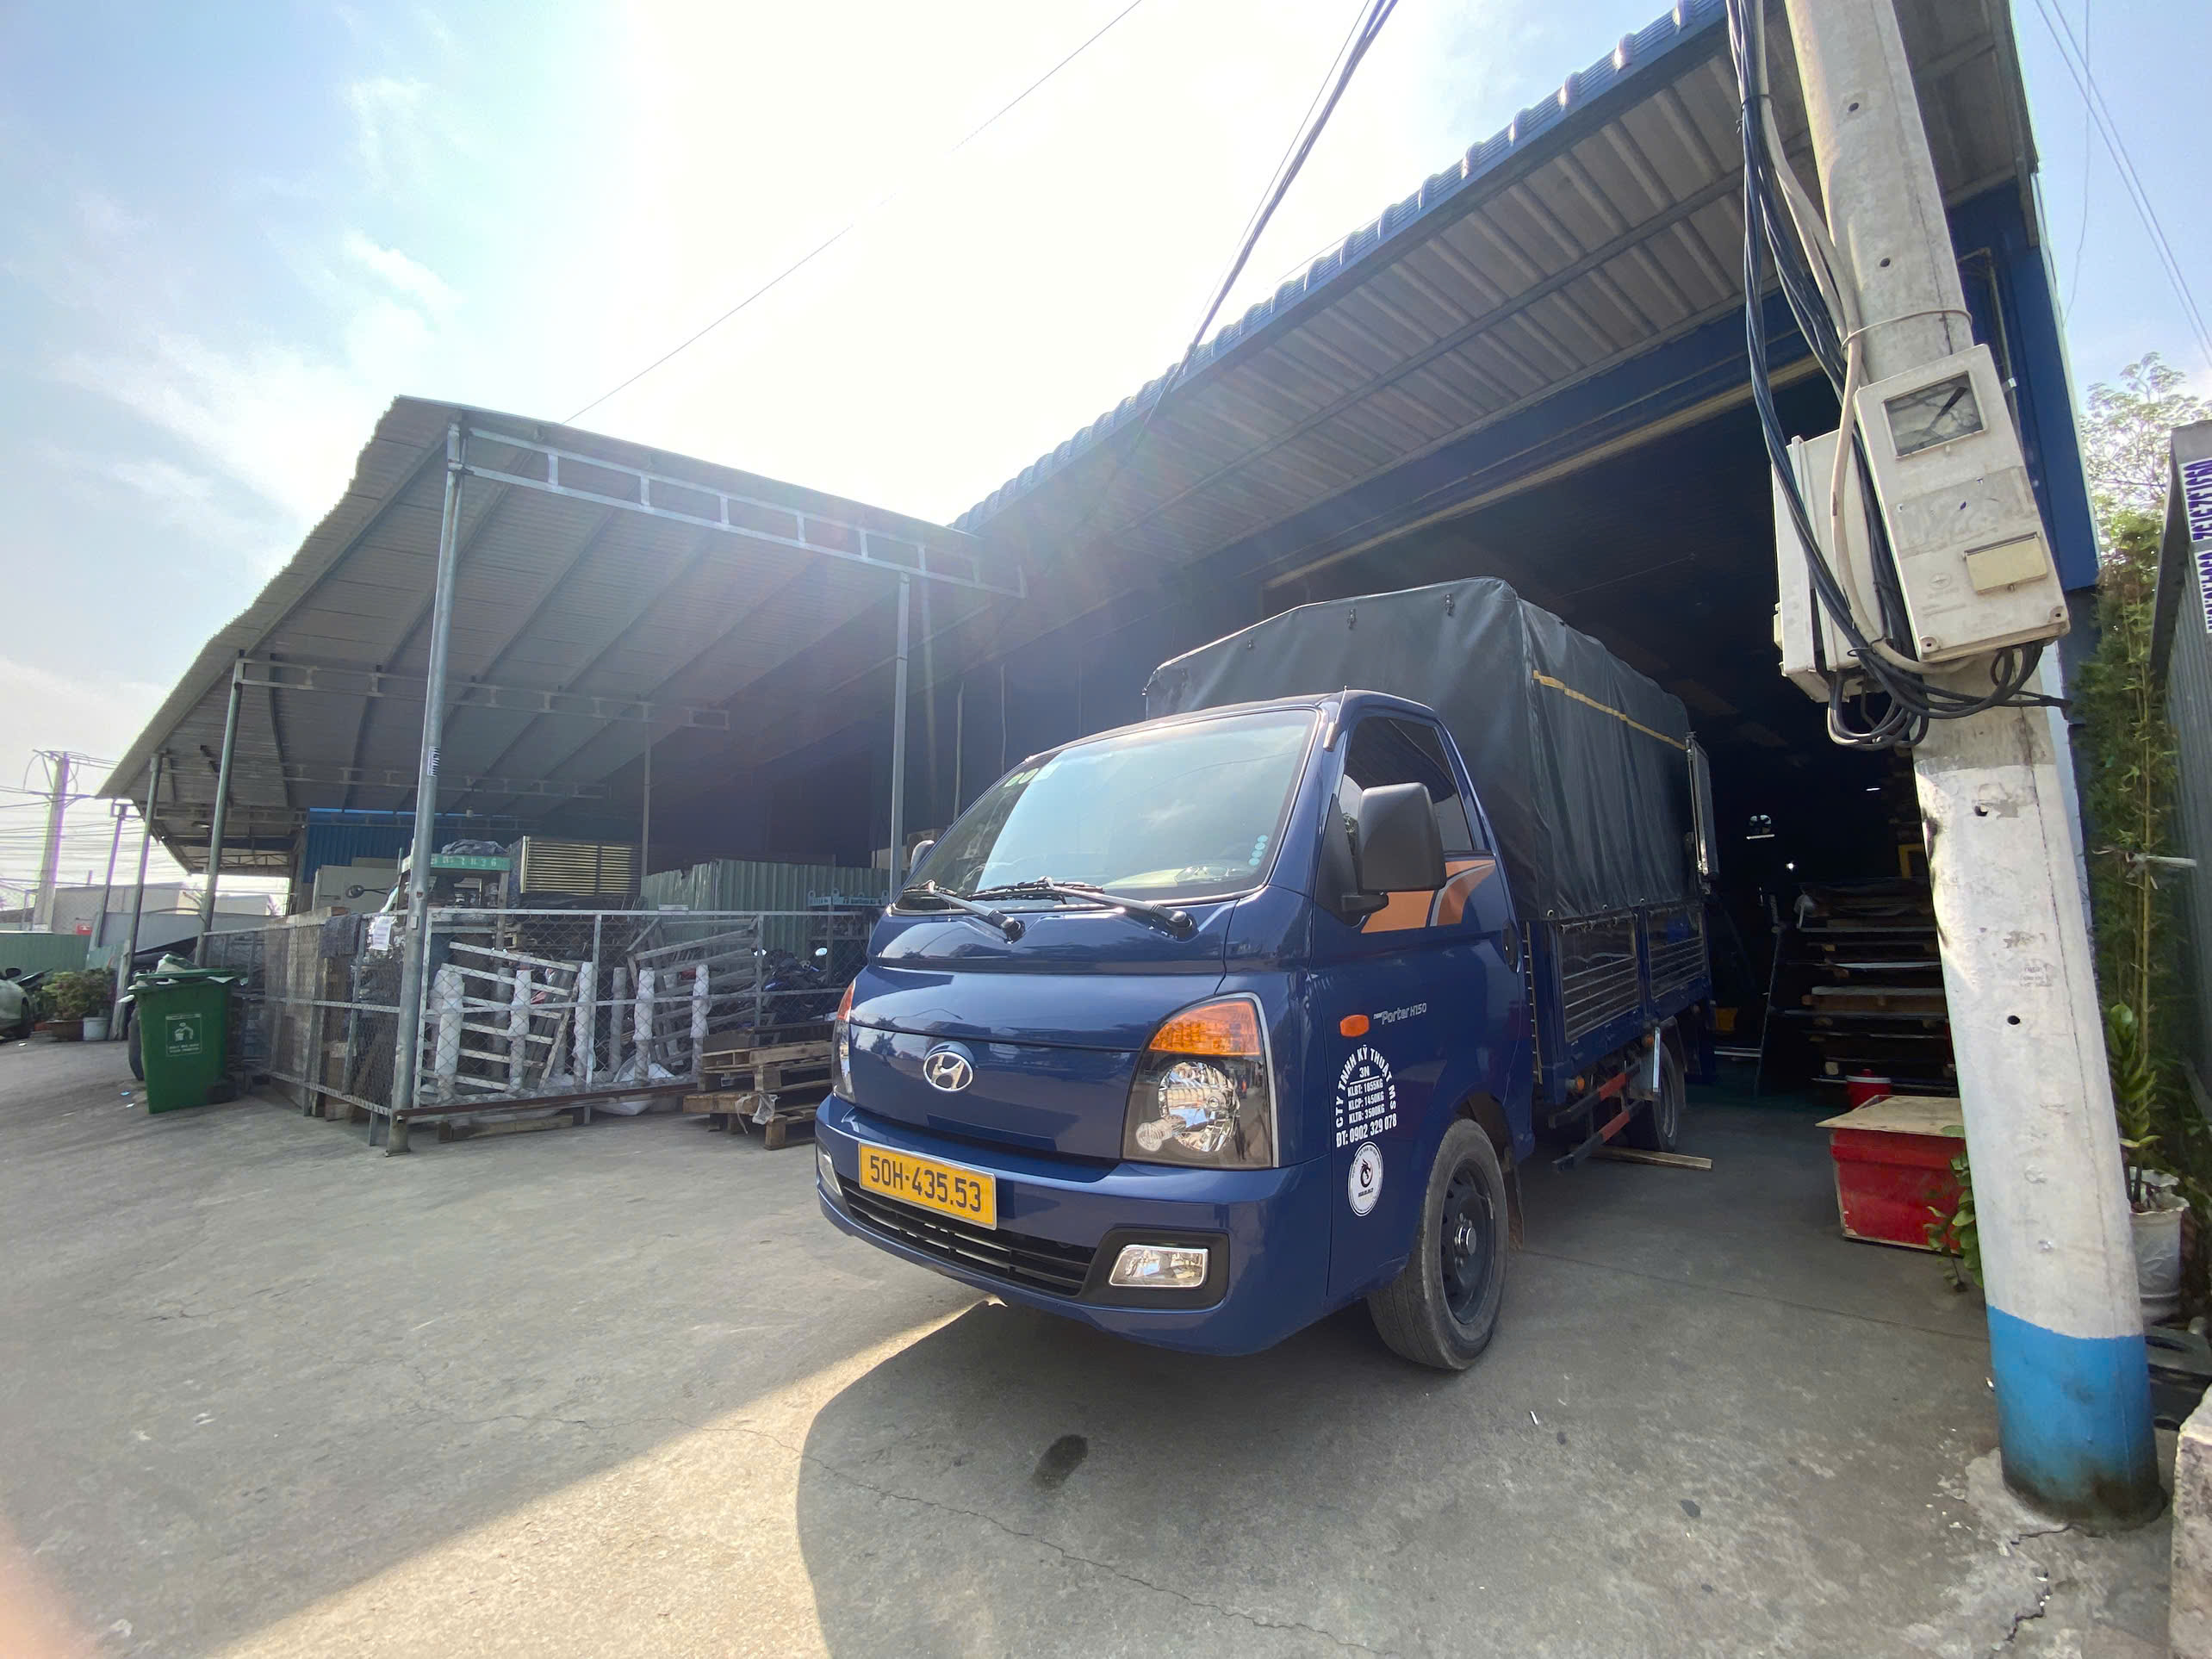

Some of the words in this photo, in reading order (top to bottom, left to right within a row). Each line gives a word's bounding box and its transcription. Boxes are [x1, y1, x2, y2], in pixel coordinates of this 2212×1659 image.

[1382, 1008, 1409, 1025] Porter
[1410, 1003, 1426, 1016] H150
[1338, 1053, 1357, 1091] TNHH
[1357, 1044, 1368, 1062] KỸ
[1359, 1066, 1370, 1078] 3N
[1348, 1098, 1364, 1111] KLCP:
[1349, 1123, 1368, 1143] 0902
[1370, 1118, 1383, 1136] 329
[1384, 1113, 1397, 1130] 078
